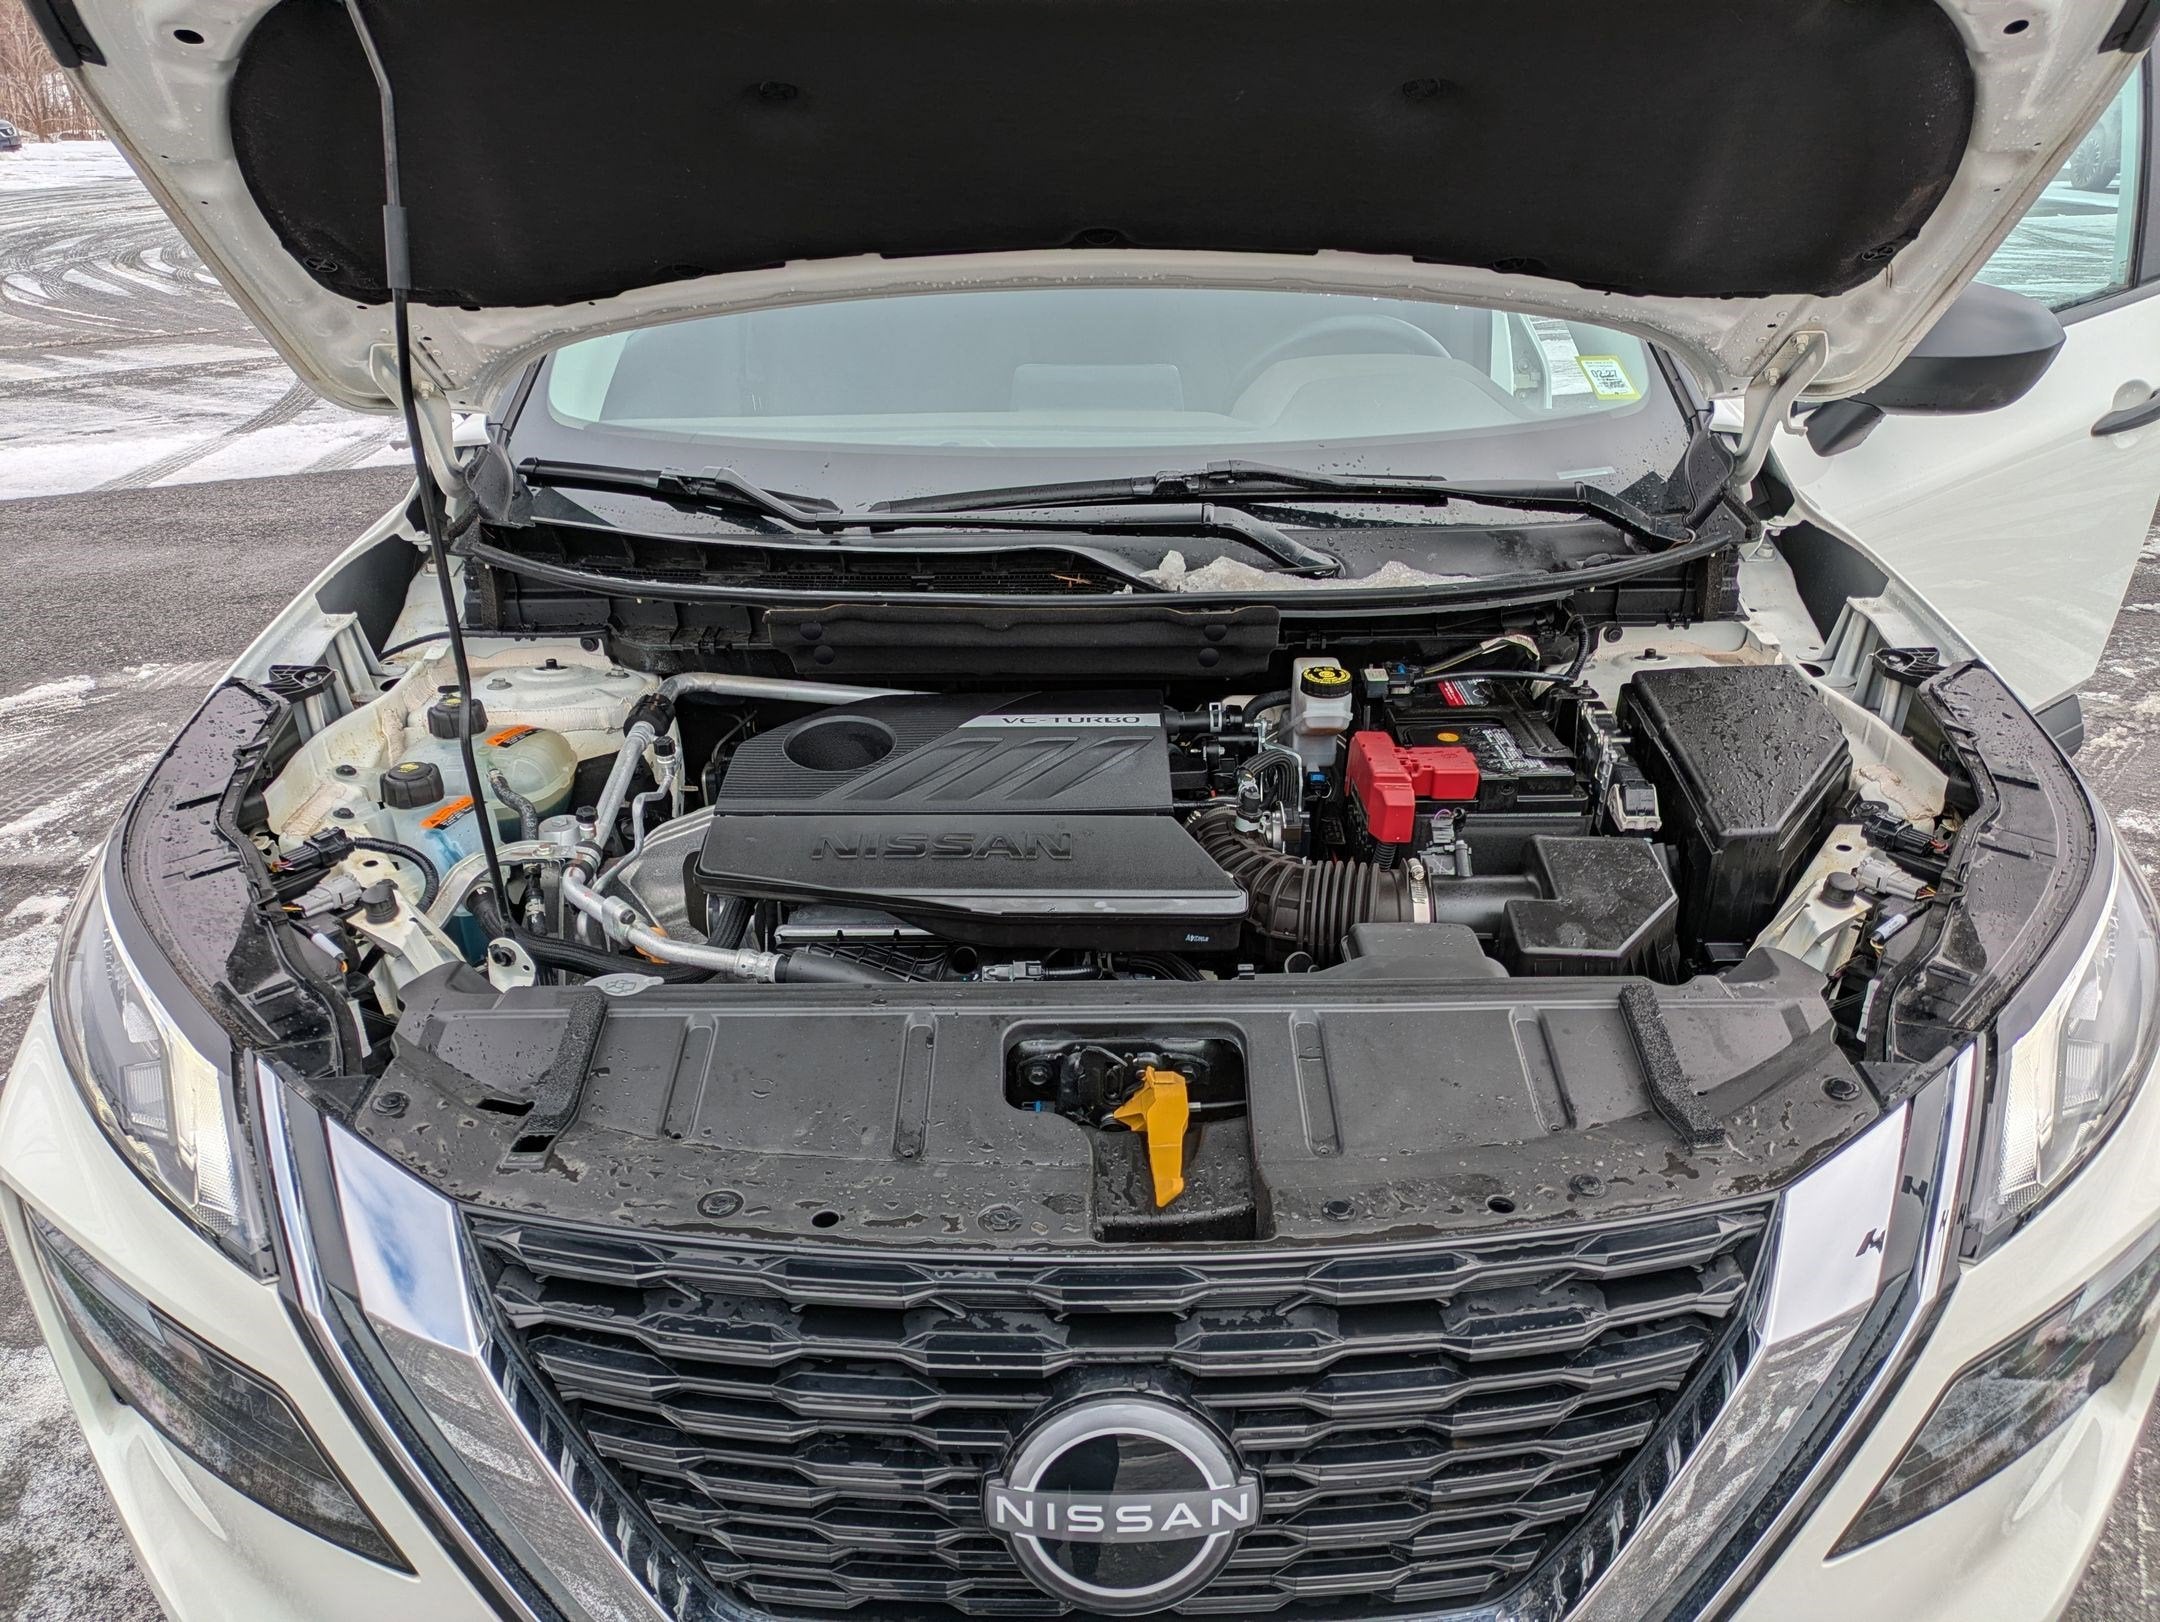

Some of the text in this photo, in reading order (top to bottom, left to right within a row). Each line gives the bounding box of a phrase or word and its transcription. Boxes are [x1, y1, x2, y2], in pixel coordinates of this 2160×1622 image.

[1002, 716, 1141, 724] VC-TURBO
[811, 832, 1072, 861] NISSAN
[996, 1493, 1248, 1533] NISSAN
